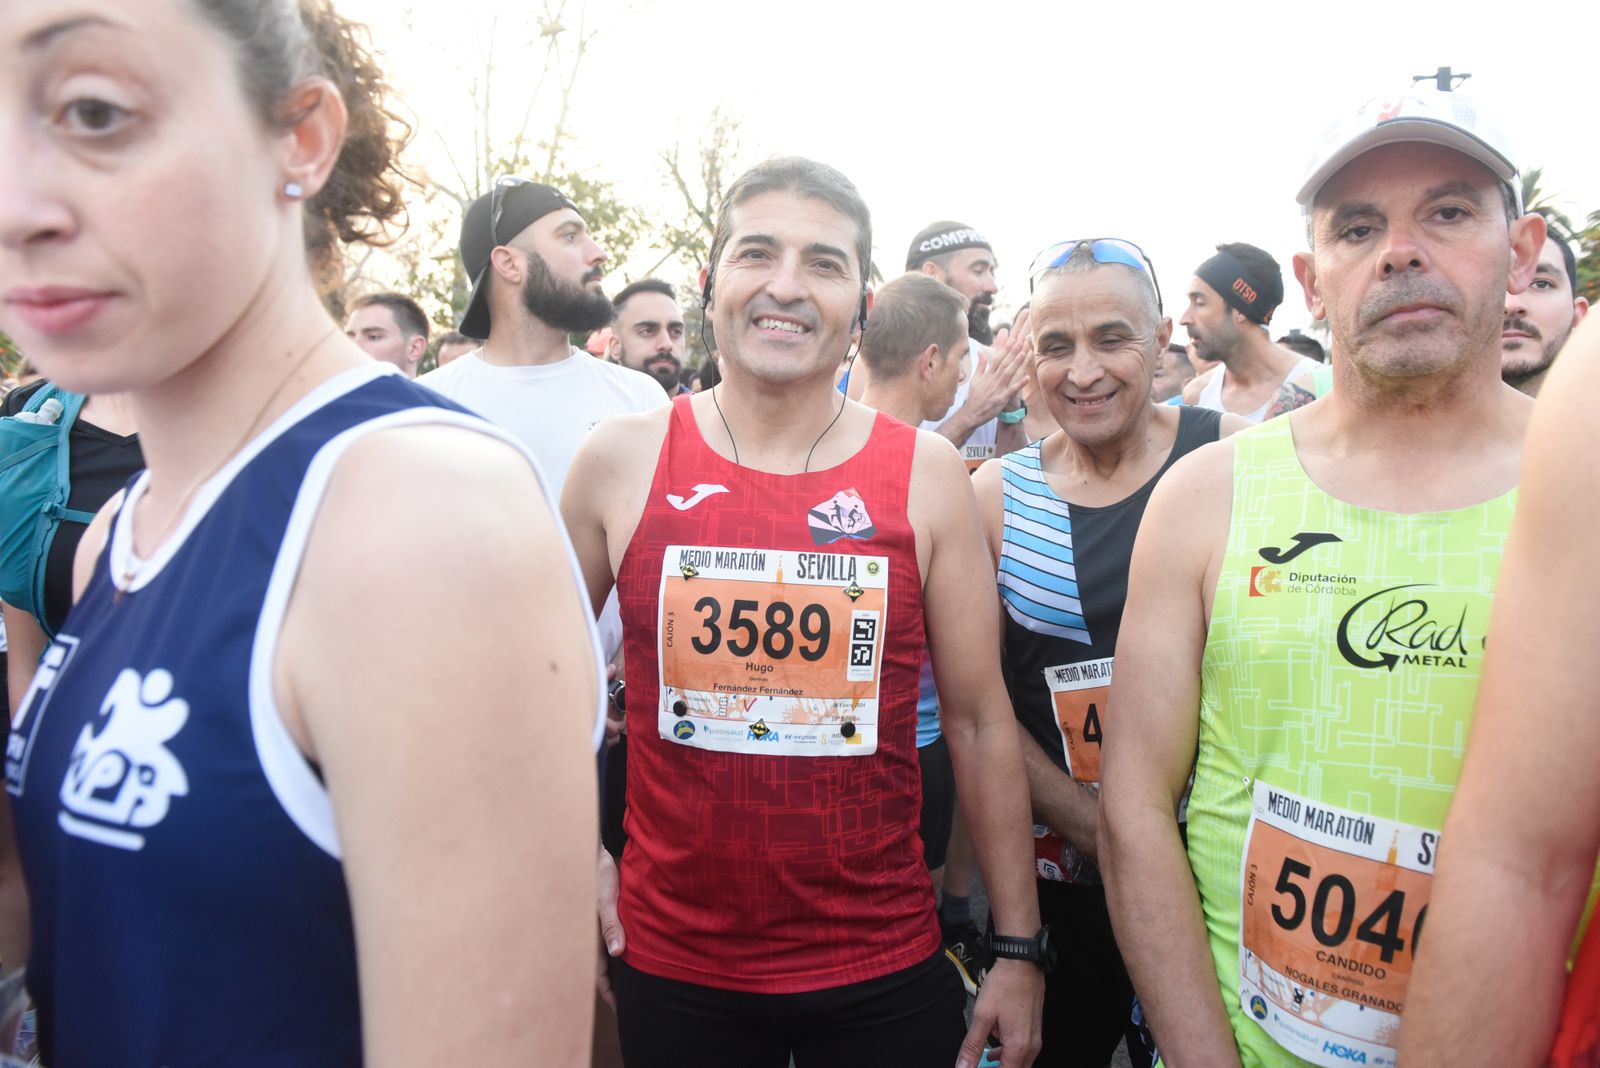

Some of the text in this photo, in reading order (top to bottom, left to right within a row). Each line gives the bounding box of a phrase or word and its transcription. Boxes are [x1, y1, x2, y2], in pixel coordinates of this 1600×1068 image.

[679, 549, 766, 572] MEDIO MARATÓN
[797, 553, 857, 581] SEVILLA
[1287, 584, 1357, 596] de Córdoba
[1289, 572, 1357, 585] Diputación
[666, 620, 674, 648] CAJÓN
[691, 596, 831, 662] 3589
[1365, 596, 1468, 656] Rad
[745, 662, 774, 674] Hugo
[1054, 666, 1081, 684] MEDIO
[1402, 654, 1467, 668] METAL
[713, 683, 803, 696] Fernández Fernández
[1268, 790, 1375, 846] MEDIO MARATÓN
[1417, 832, 1440, 868] S
[1248, 874, 1257, 906] CAJÓN
[1316, 950, 1386, 980] CANDIDO
[1285, 965, 1339, 994] NOGALES
[1322, 1040, 1367, 1064] HOKA
